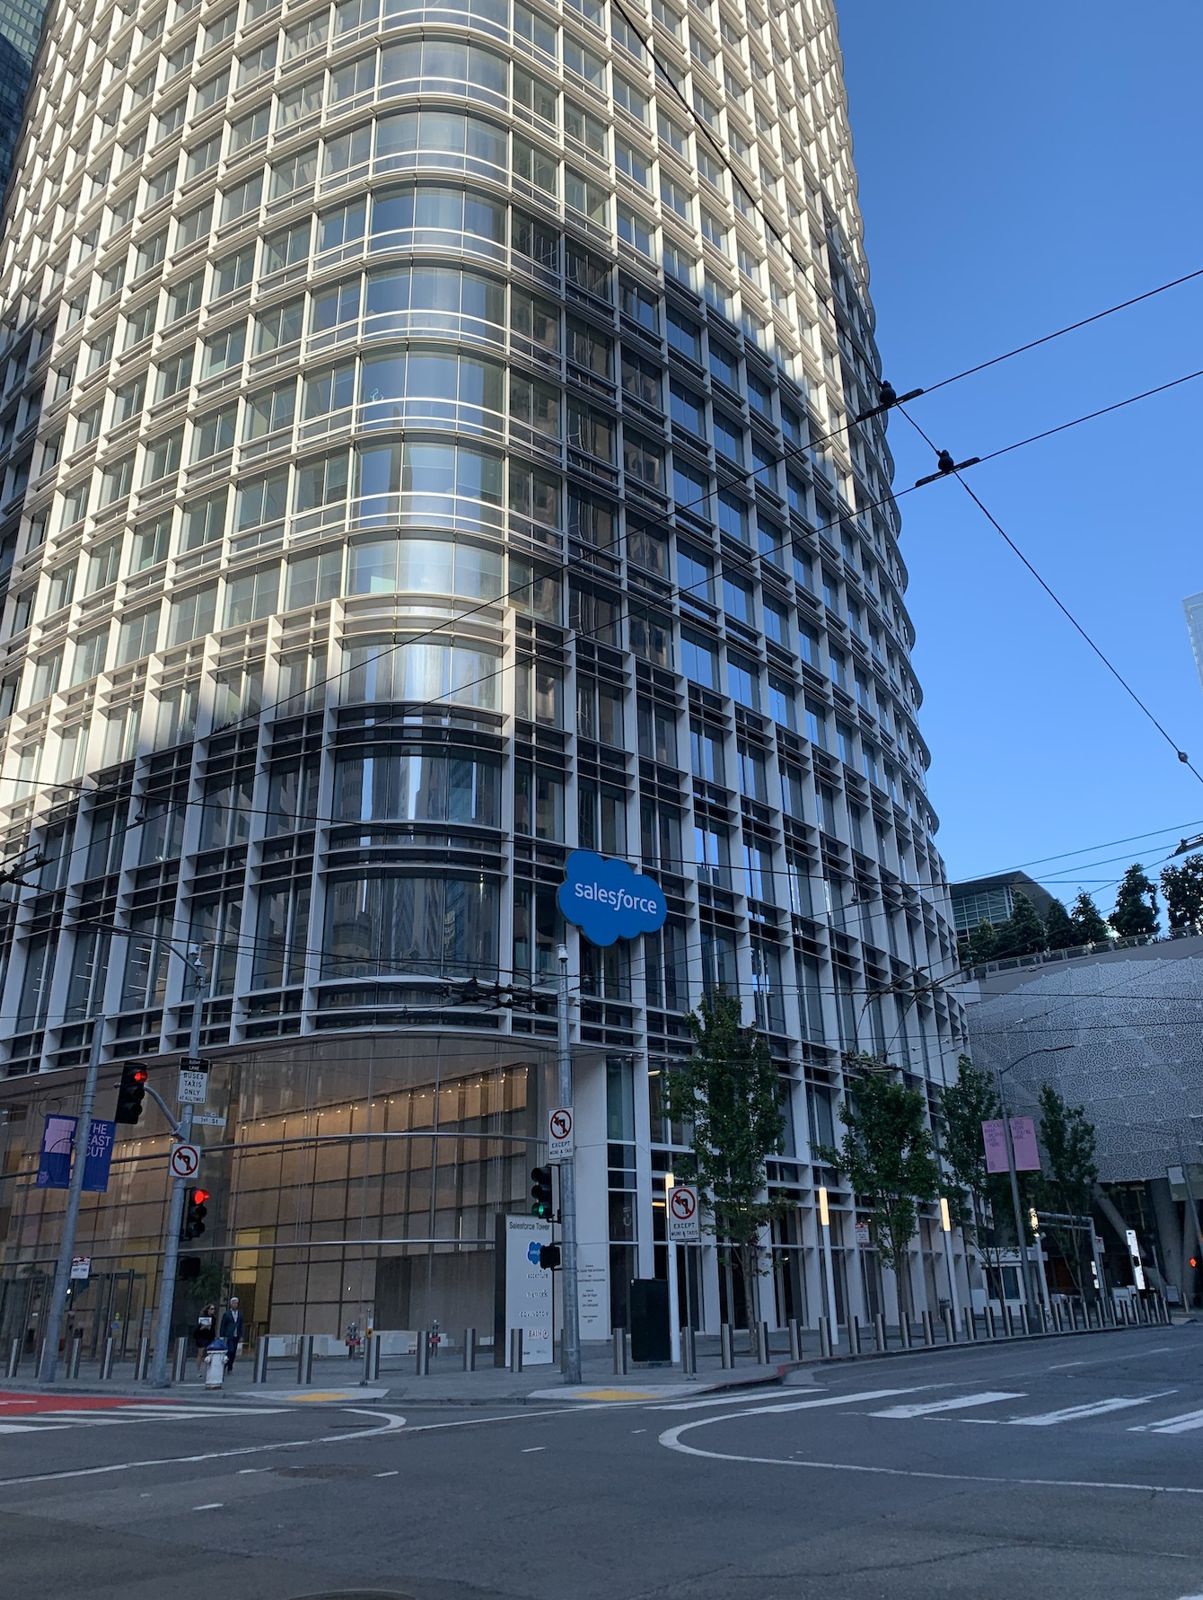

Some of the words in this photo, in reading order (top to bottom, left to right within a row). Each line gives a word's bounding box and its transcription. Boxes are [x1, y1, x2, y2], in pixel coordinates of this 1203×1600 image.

[575, 882, 657, 914] salesforce
[184, 1072, 204, 1080] BUSES
[184, 1080, 202, 1088] TAXIS
[551, 1140, 571, 1149] EXCEPT
[509, 1221, 535, 1230] Salesforce
[536, 1222, 550, 1231] Tower
